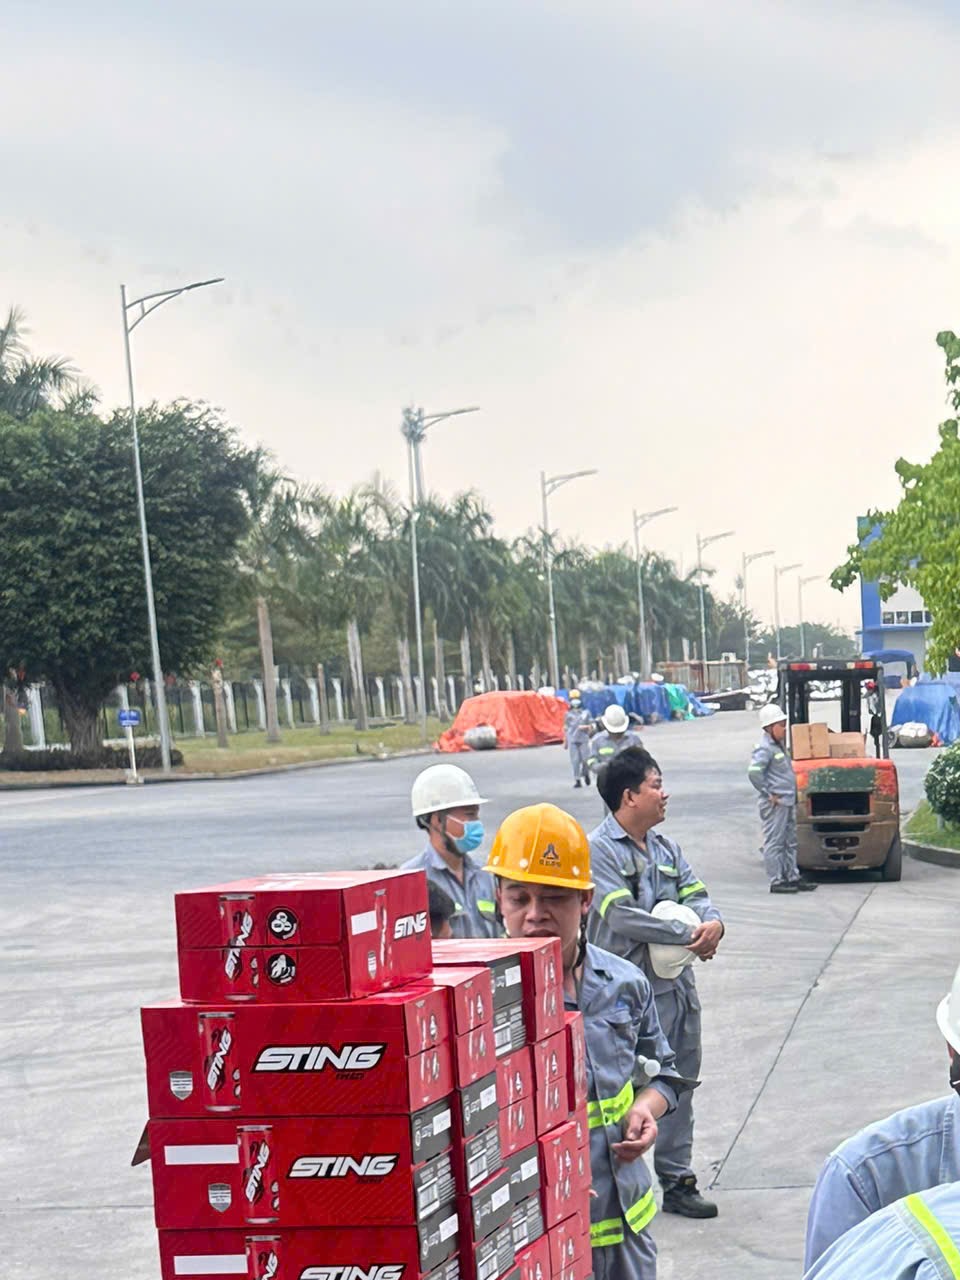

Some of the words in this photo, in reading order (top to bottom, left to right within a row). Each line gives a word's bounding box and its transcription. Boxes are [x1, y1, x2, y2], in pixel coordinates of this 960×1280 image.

[225, 911, 254, 980] STING
[394, 911, 427, 939] STING
[206, 1029, 232, 1090] STING
[255, 1045, 383, 1071] STING
[245, 1142, 270, 1203] STING
[289, 1155, 397, 1178] STING
